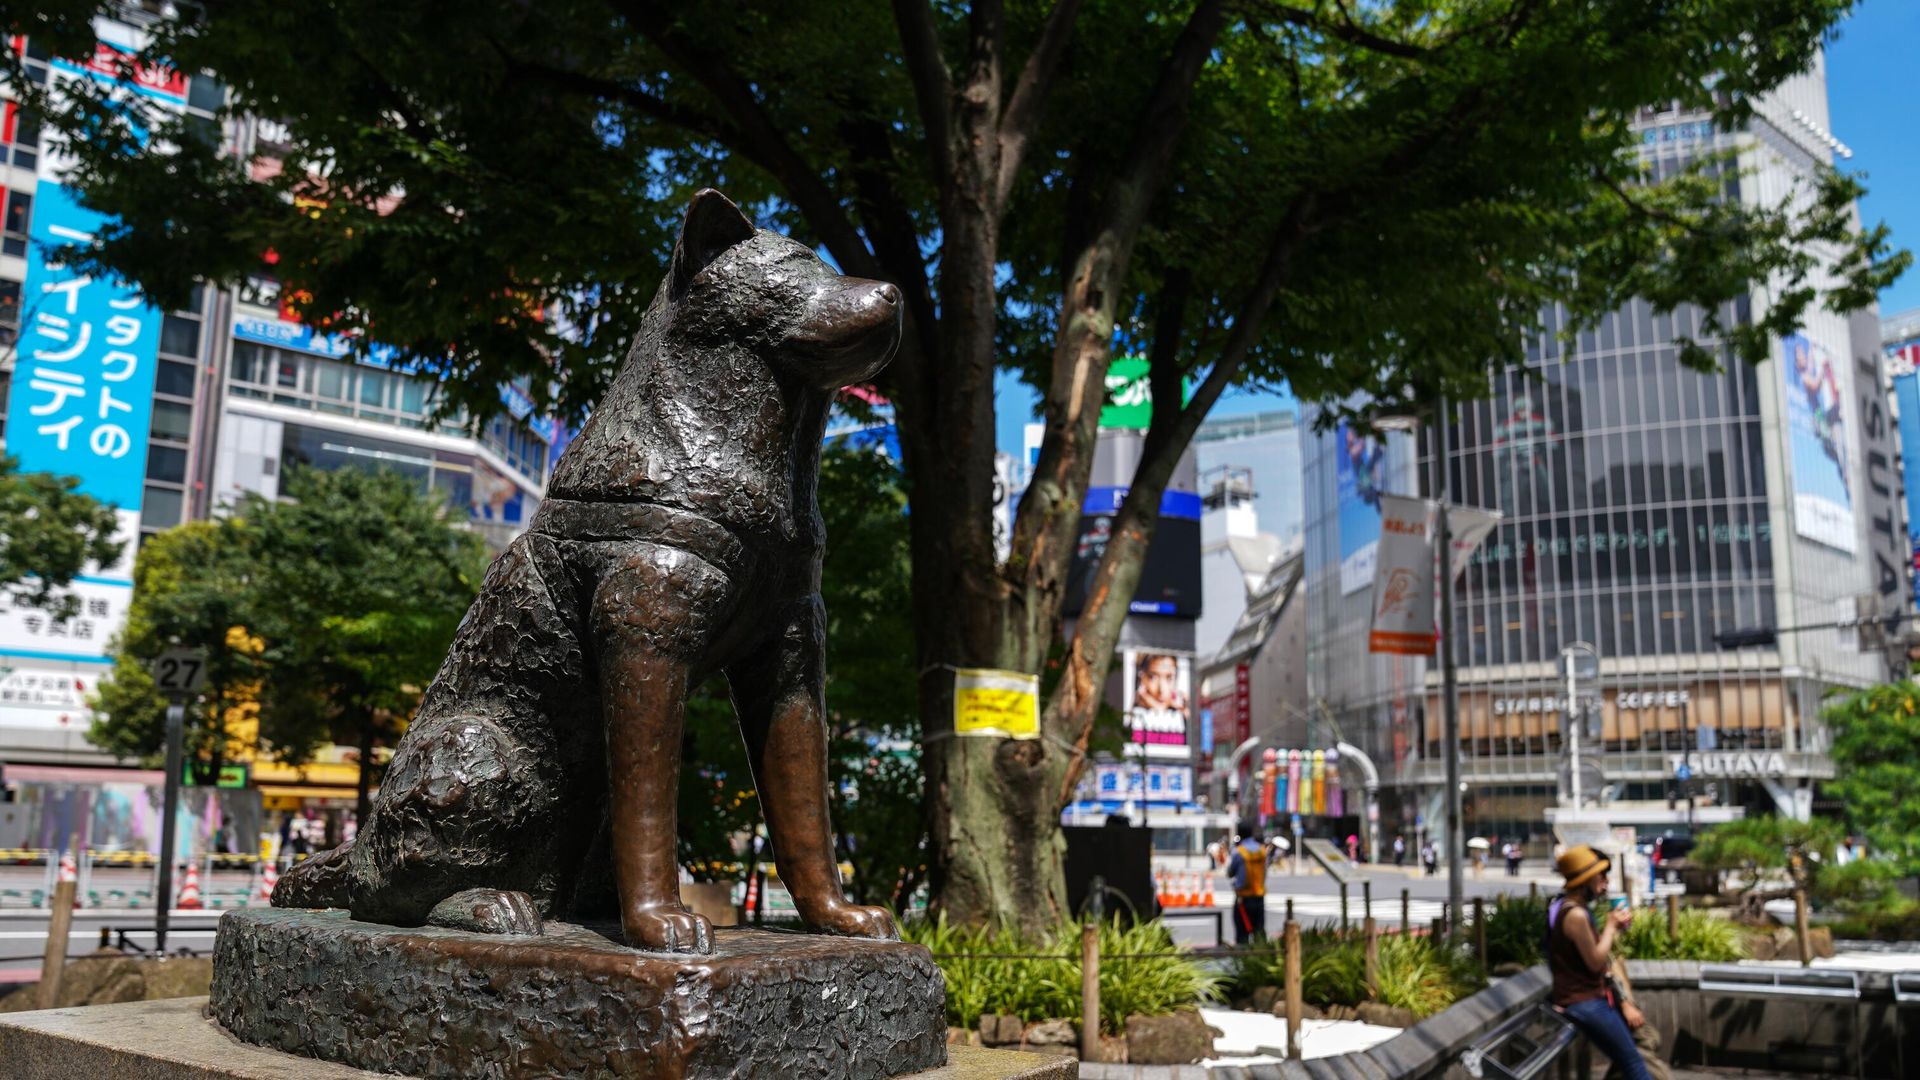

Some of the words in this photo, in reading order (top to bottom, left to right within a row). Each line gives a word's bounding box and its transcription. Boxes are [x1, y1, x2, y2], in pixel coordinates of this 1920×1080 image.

[160, 657, 203, 688] 27
[1617, 690, 1690, 710] COFFEE
[1669, 752, 1787, 775] TSUTAYA
